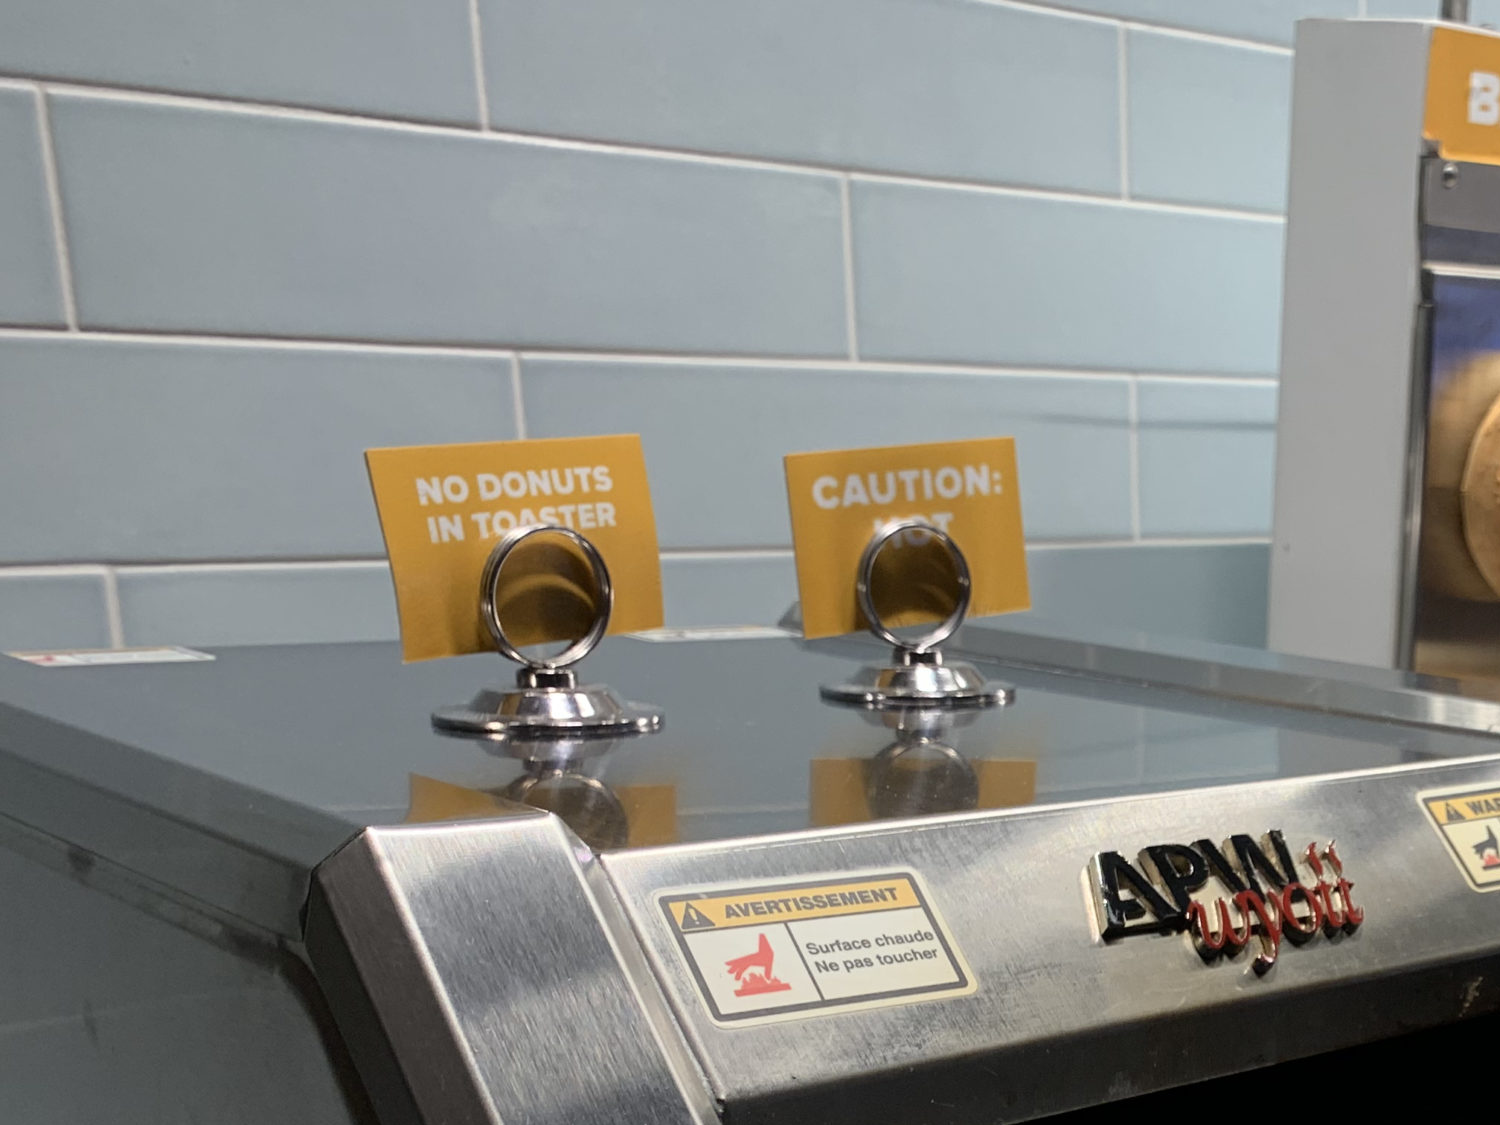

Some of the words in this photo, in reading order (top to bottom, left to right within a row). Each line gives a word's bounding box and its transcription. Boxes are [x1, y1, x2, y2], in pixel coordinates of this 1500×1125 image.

[415, 474, 469, 507] NO
[476, 465, 614, 502] DONUTS
[811, 463, 1003, 510] CAUTION:
[427, 514, 465, 544] IN
[470, 501, 617, 540] TOASTER
[725, 887, 898, 919] AVERTISSEMENT
[806, 936, 871, 956] Surface
[875, 929, 935, 948] chaude
[815, 958, 840, 974] Ne
[844, 955, 874, 974] pas
[878, 947, 939, 967] toucher
